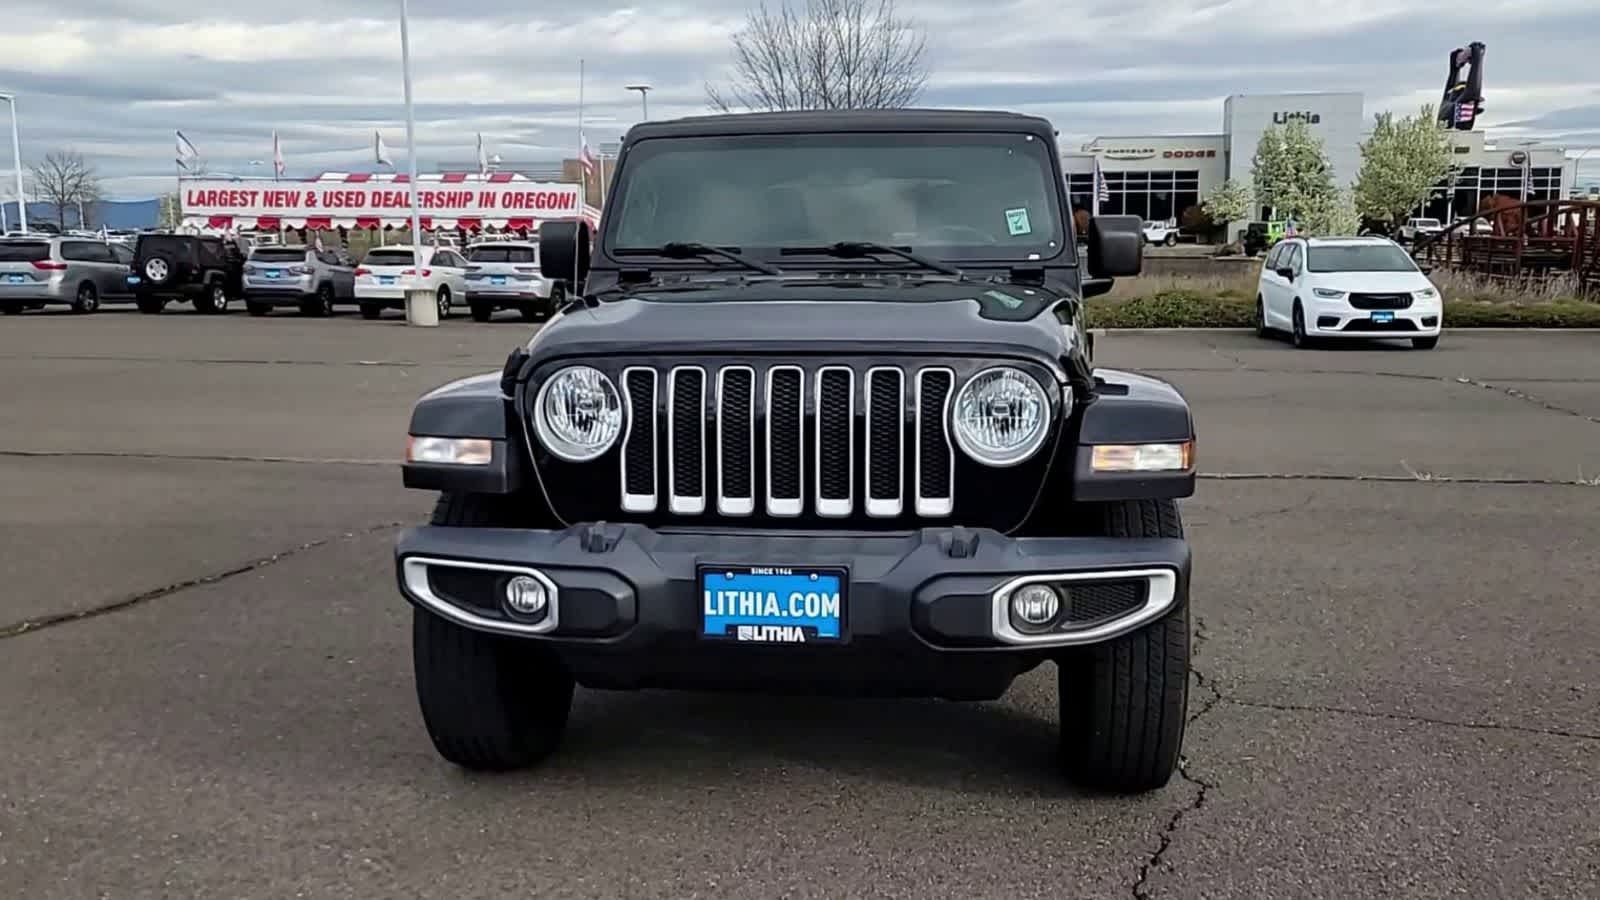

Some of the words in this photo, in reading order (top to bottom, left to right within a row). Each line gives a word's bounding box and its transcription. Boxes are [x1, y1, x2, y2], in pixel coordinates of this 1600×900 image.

[1163, 150, 1216, 158] DODGE
[187, 190, 258, 207] LARGEST
[263, 191, 300, 207] NEW
[304, 191, 317, 207] &
[322, 191, 367, 208] USED
[371, 191, 474, 208] DEALERSHIP
[478, 191, 496, 208] IN
[502, 191, 577, 209] OREGON!
[751, 567, 774, 575] SINCE
[704, 590, 840, 618] LITHIA.COM
[753, 626, 805, 642] LITHIA
